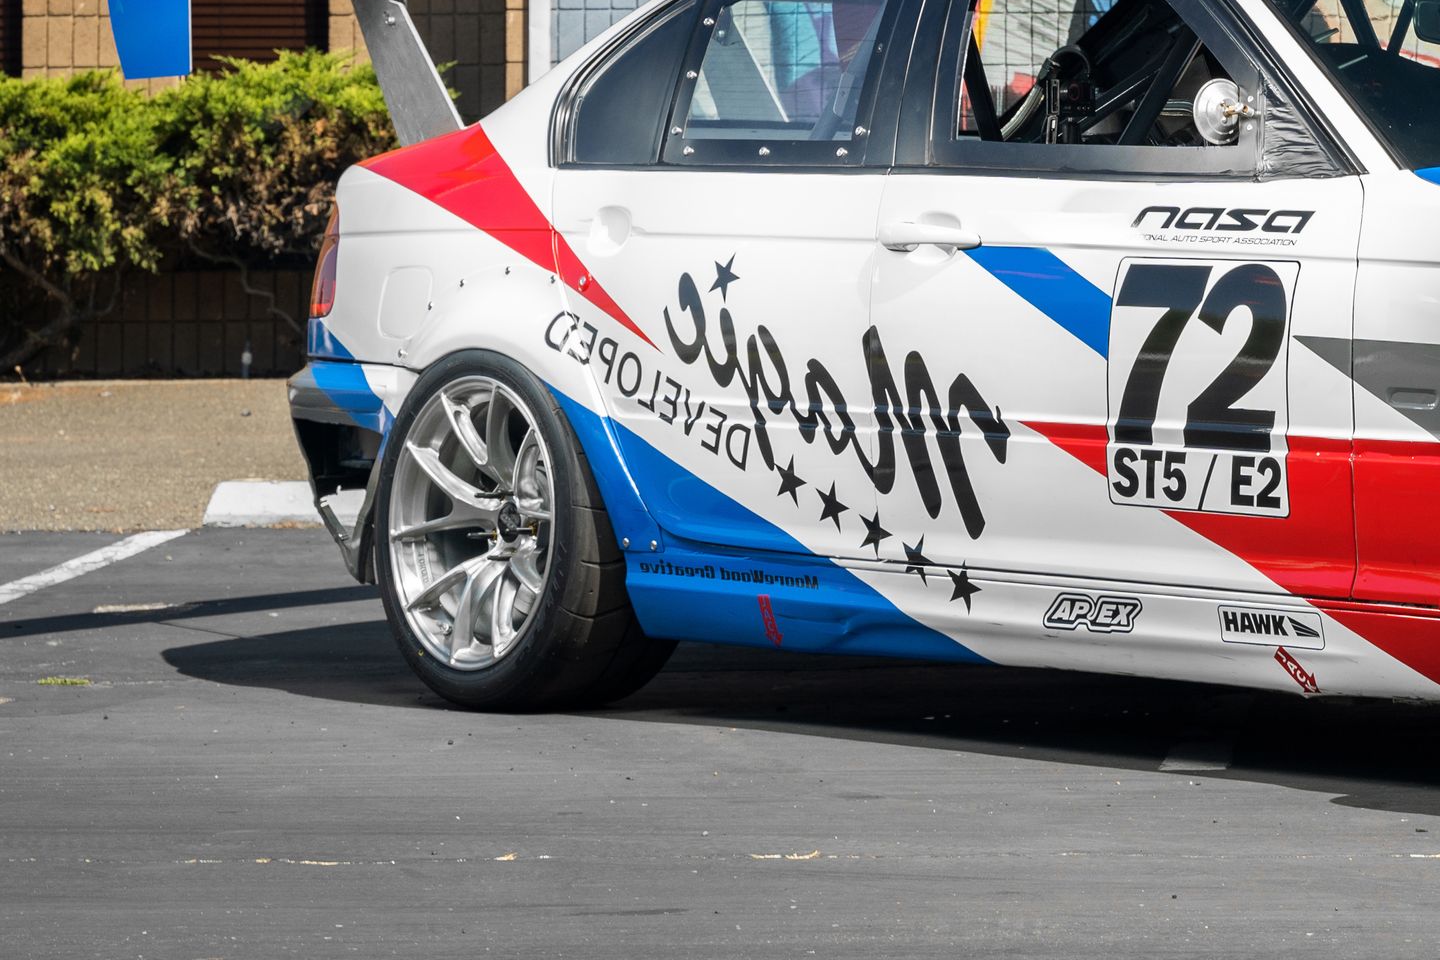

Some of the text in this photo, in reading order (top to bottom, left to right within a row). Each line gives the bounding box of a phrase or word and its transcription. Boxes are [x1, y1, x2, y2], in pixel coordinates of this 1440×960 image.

[1171, 235, 1198, 243] AUTO
[1200, 236, 1232, 245] SPORT
[1234, 237, 1298, 247] ASSOCIATION
[1115, 263, 1287, 452] 72
[1112, 448, 1187, 502] ST5
[1230, 455, 1281, 508] E2
[1223, 611, 1288, 636] HAWK
